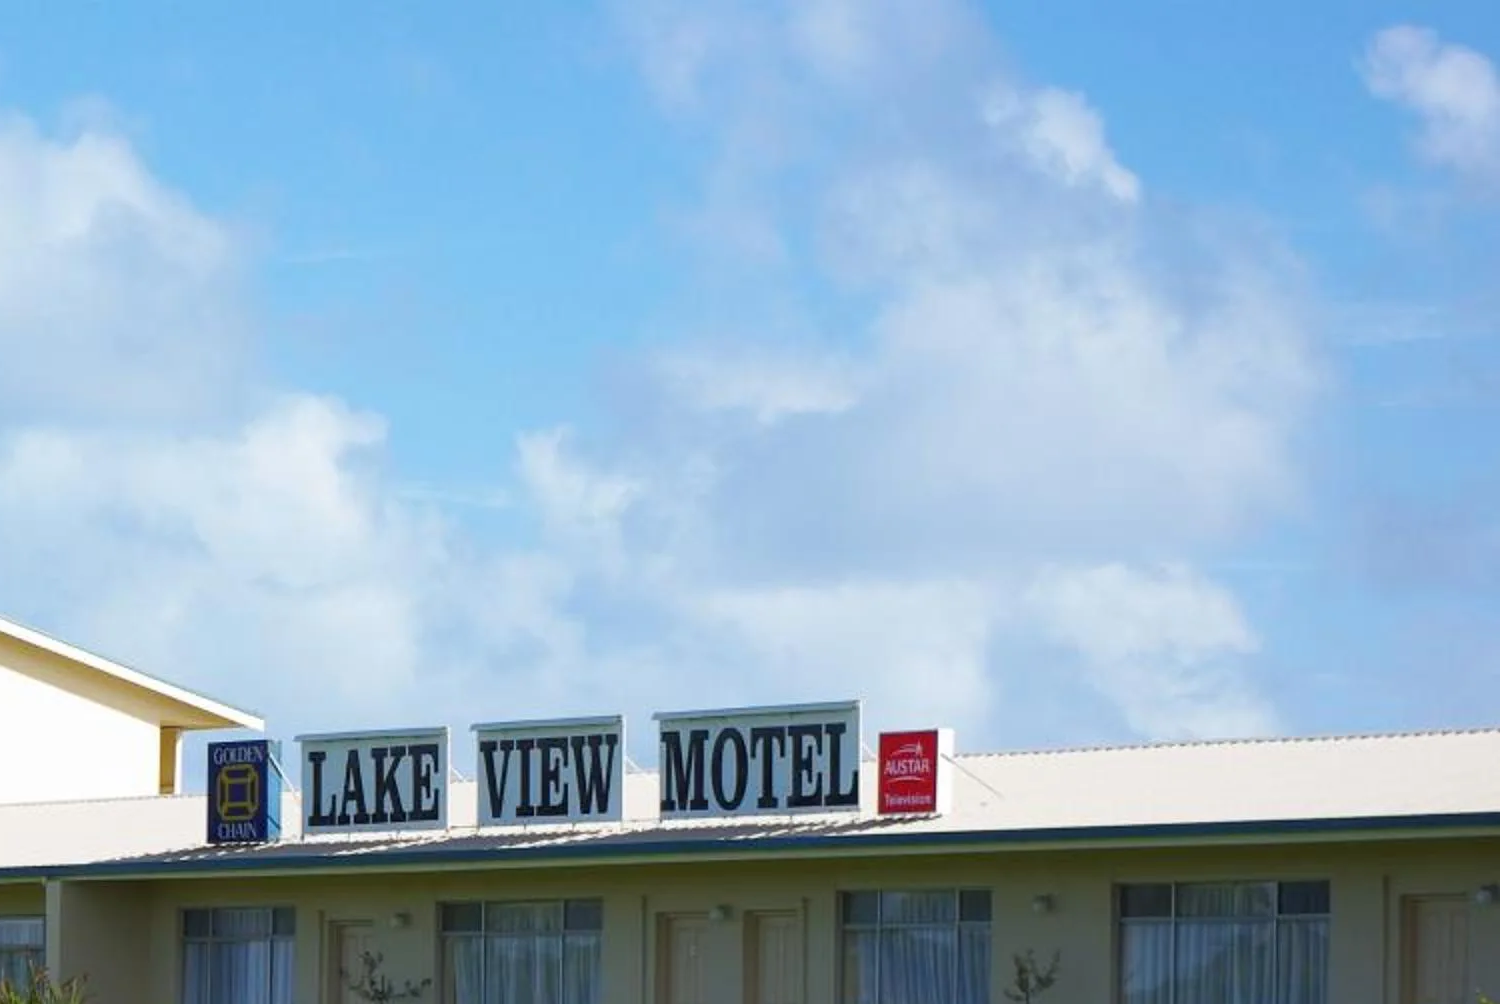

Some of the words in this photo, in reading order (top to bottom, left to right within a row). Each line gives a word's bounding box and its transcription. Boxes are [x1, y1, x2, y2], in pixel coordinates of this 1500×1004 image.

[213, 745, 264, 765] GOLDEN
[308, 743, 439, 826] LAKE
[479, 732, 618, 819] VIEW
[660, 722, 859, 812] MOTEL
[884, 758, 930, 776] AUSTAR
[217, 822, 257, 839] CHAIN
